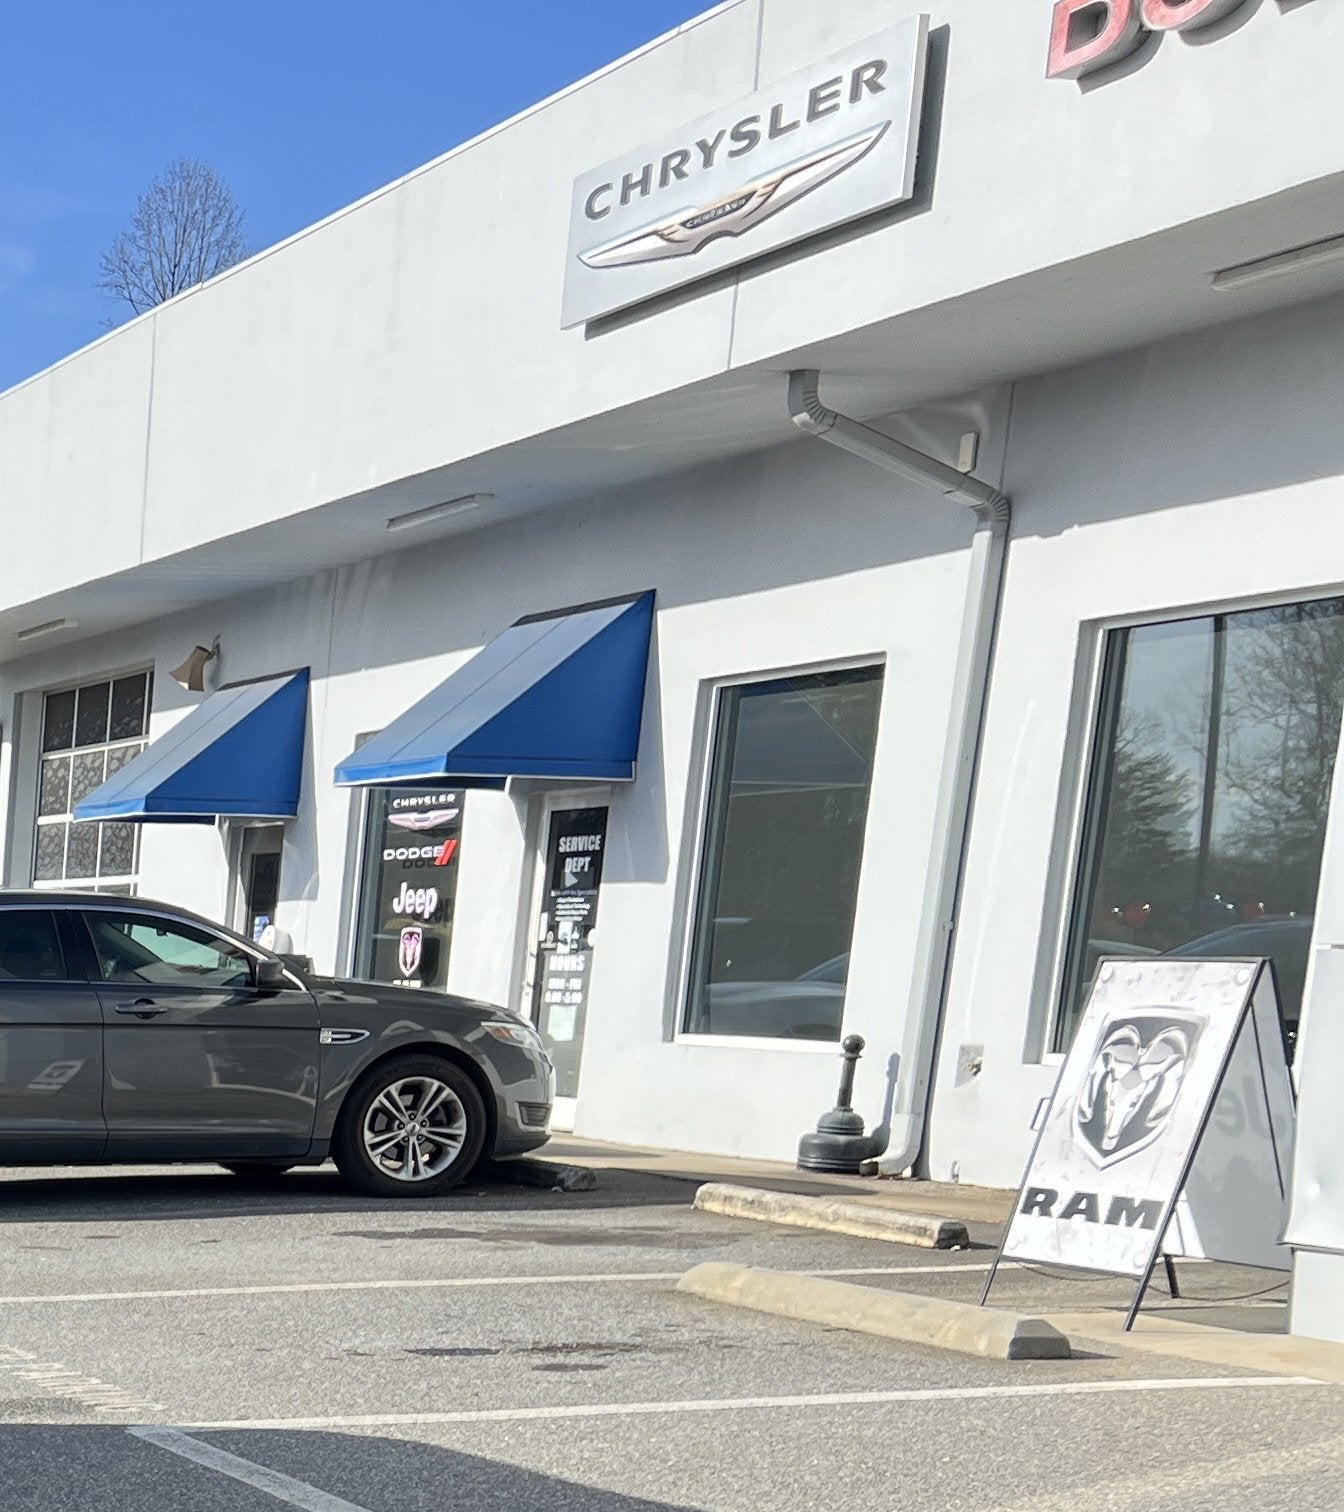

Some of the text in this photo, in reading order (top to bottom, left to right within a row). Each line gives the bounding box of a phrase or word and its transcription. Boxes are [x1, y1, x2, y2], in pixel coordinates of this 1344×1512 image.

[585, 59, 887, 220] CHRYSLER
[392, 793, 456, 809] CHRYSLER
[383, 845, 444, 861] DODGE
[559, 834, 602, 853] SERVICE
[564, 856, 591, 873] DEPT
[392, 881, 438, 919] Jeep
[1020, 1186, 1165, 1230] RAM
